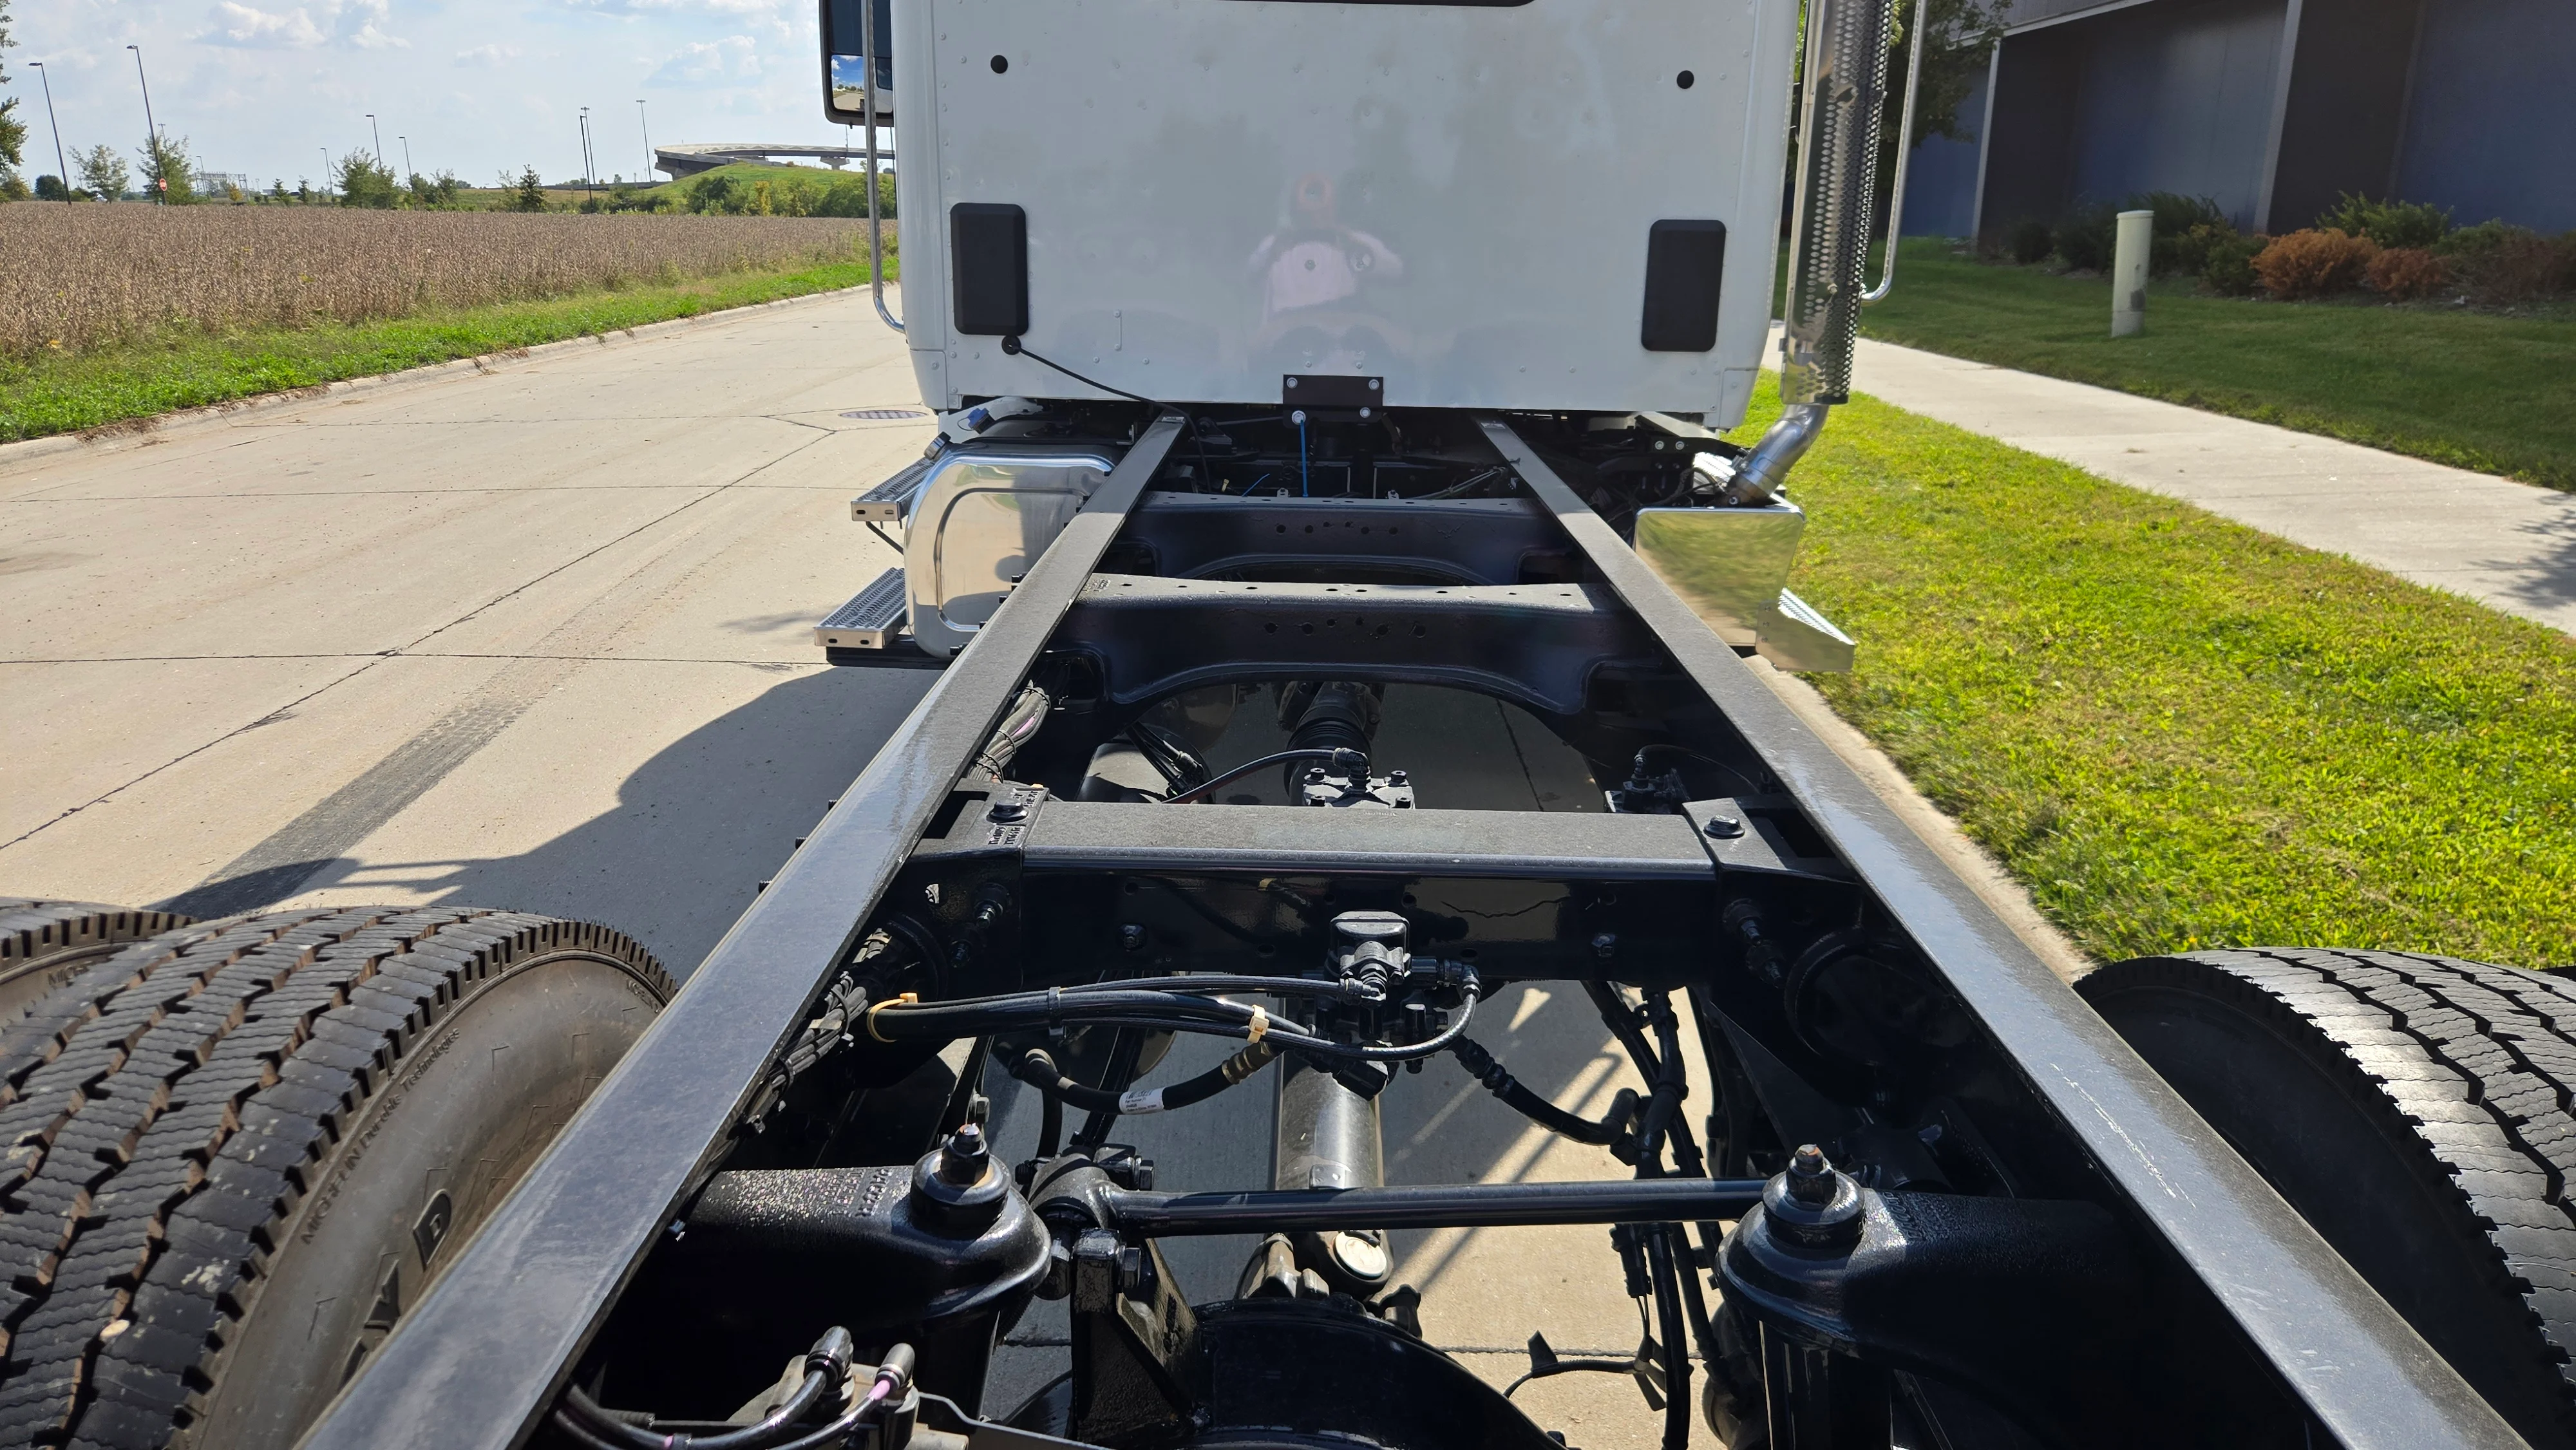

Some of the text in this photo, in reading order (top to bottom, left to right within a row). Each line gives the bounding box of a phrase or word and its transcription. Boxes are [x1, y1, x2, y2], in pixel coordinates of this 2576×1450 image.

[301, 1028, 460, 1245] MICHELIN Durable Technologies
